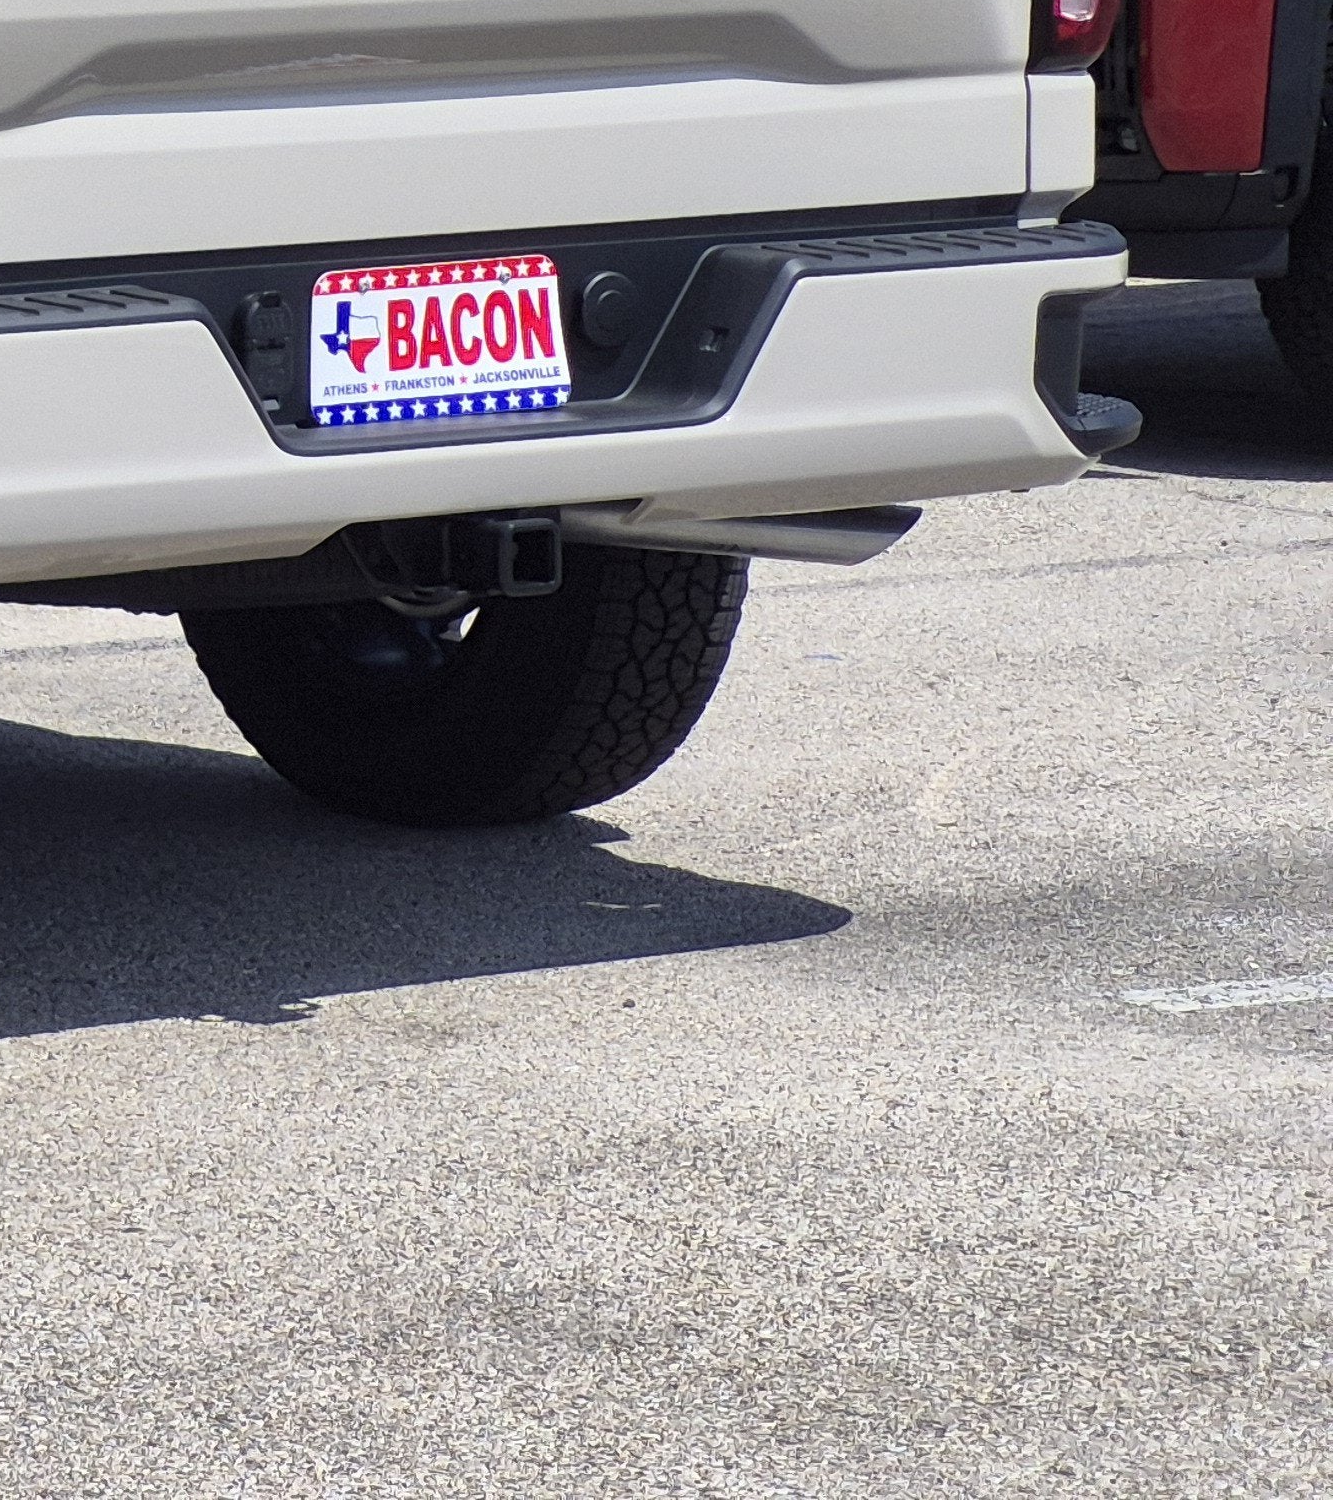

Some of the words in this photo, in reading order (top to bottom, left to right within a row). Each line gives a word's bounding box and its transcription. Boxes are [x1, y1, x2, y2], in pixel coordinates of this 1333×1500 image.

[387, 288, 556, 372] BACON
[323, 382, 368, 397] ATHENS
[385, 375, 455, 392] FRANKSTON
[473, 366, 561, 385] JACKSONVILLE
